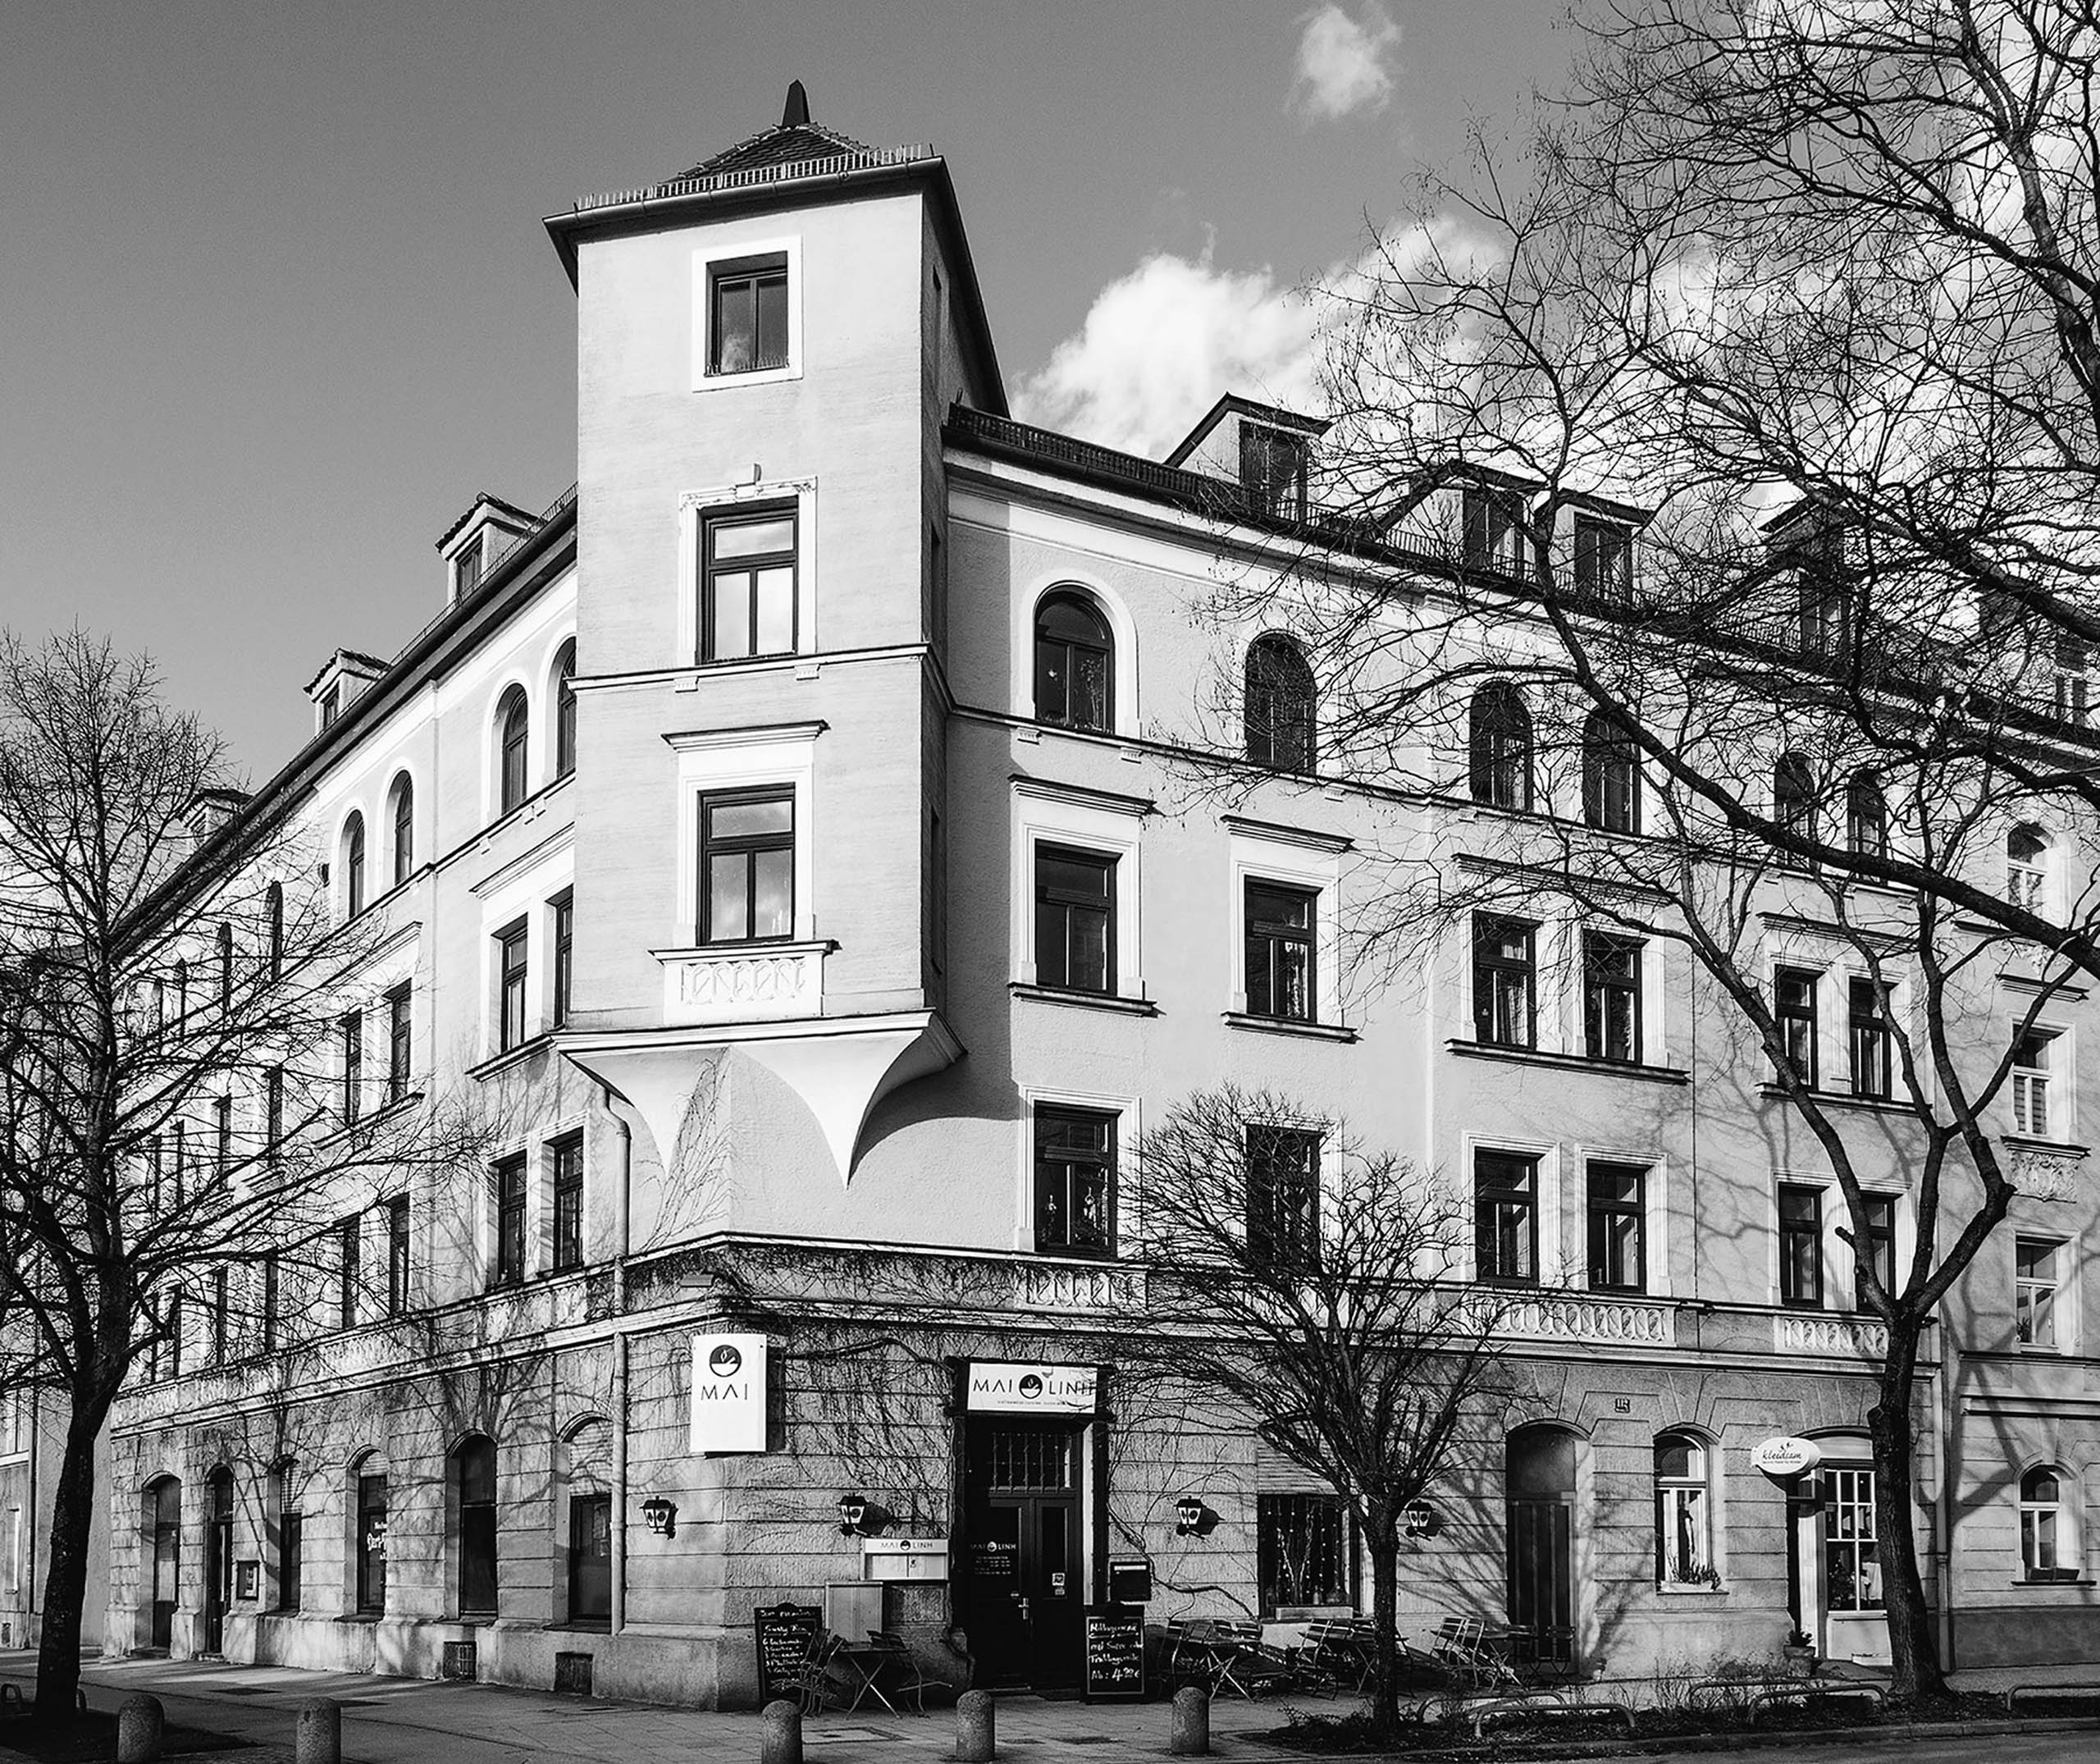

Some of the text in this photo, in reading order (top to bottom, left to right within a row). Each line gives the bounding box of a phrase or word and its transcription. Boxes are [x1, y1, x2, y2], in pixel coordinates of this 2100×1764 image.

[701, 1383, 748, 1401] MAI
[973, 1378, 1093, 1396] MAI LINH
[911, 1542, 934, 1550] LINH
